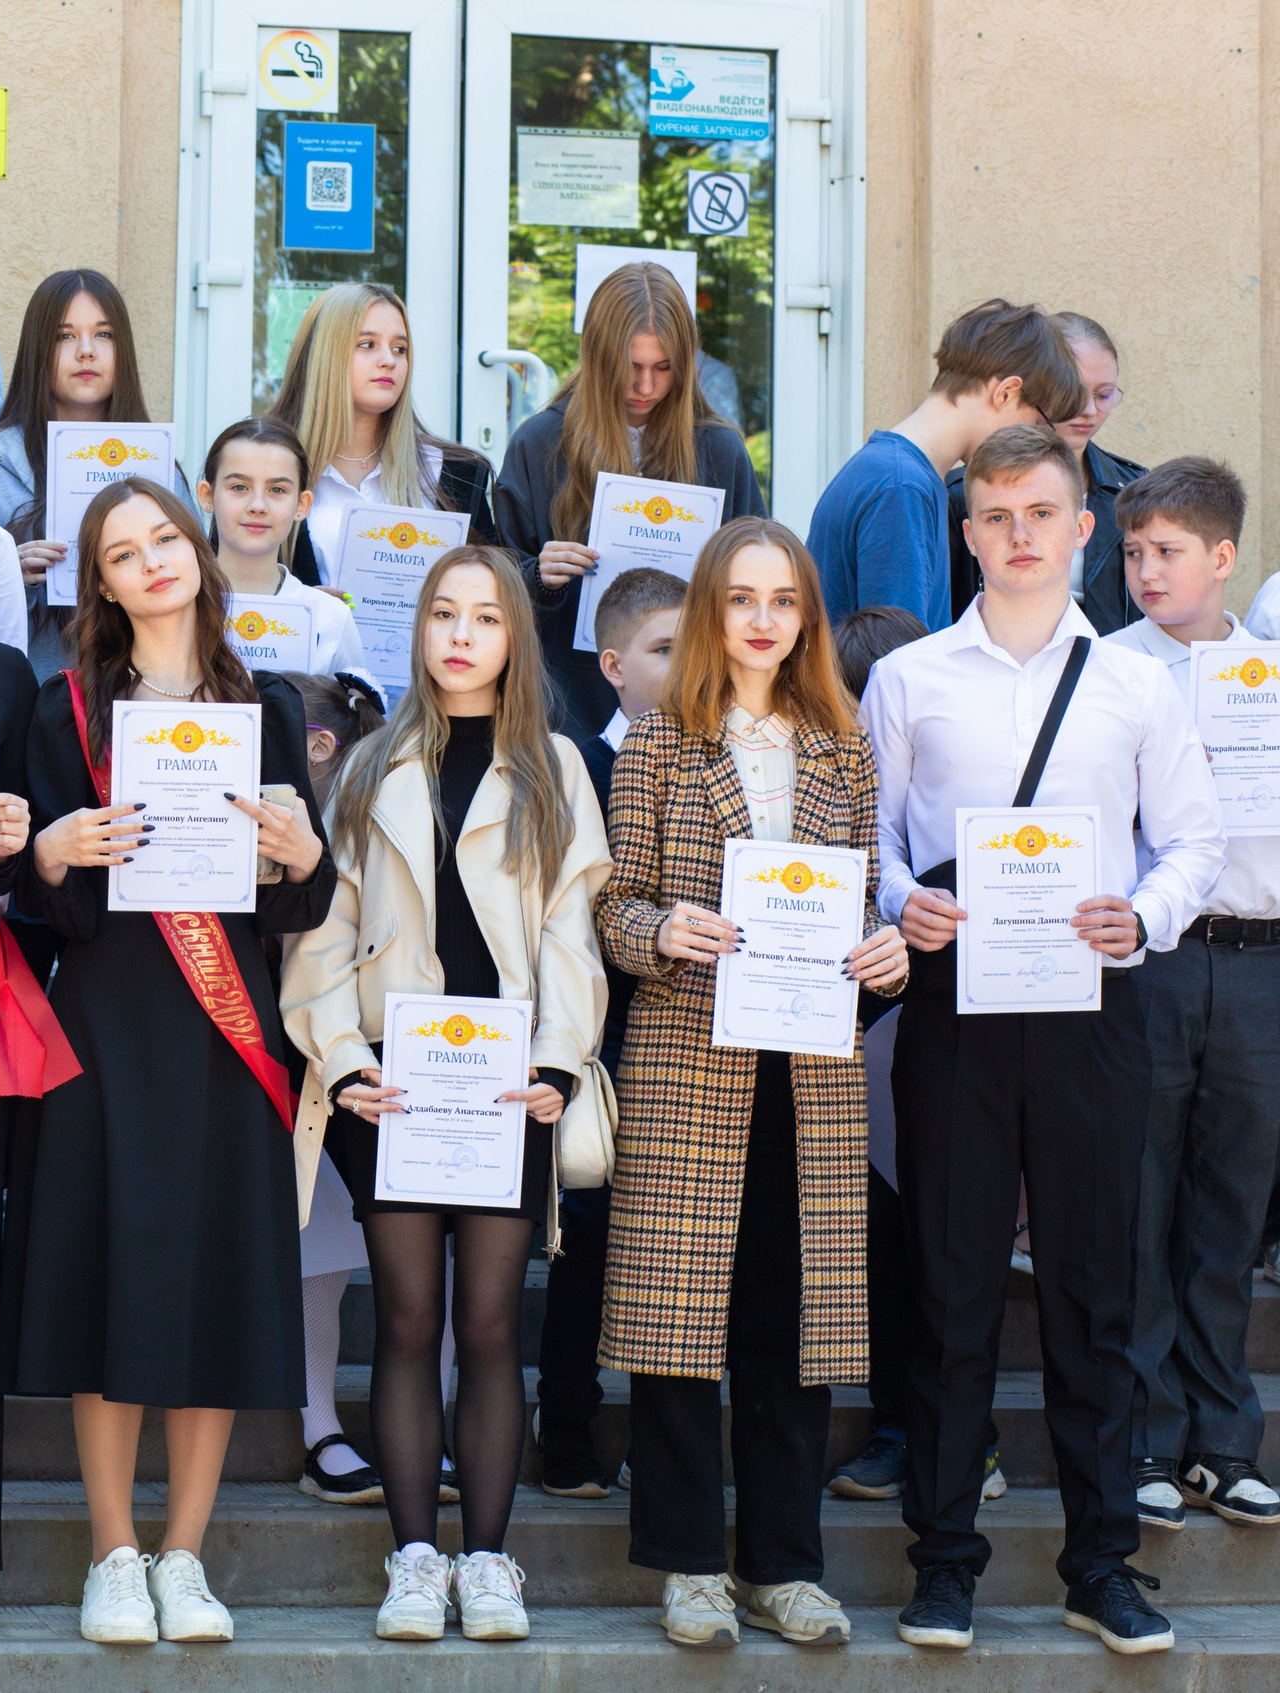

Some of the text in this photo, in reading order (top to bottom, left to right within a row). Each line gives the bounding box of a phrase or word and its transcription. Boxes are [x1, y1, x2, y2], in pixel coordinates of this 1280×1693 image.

[720, 95, 765, 106] ВЕДЁТСЯ
[656, 102, 764, 116] ВИДЕОНАБЛЮДЕНИЕ
[656, 122, 765, 137] КУРЕНИЕ ЗАПРЕЩЕНО
[629, 526, 681, 542] ГРАМОТА
[373, 551, 425, 566] ГРАМОТА
[362, 597, 396, 608] Королеву
[1227, 693, 1277, 704] ГРАМОТА
[1205, 744, 1258, 754] Накрайникова
[157, 759, 217, 771] ГРАМОТА
[143, 814, 229, 824] Семенову Ангелину
[1002, 863, 1060, 874] ГРАМОТА
[767, 897, 825, 913] ГРАМОТА
[993, 917, 1069, 926] Лагушина Данилу
[748, 951, 836, 967] Моткову Александру
[428, 1051, 487, 1065] ГРАМОТА
[407, 1105, 502, 1117] Алдабаеву Анастасию
